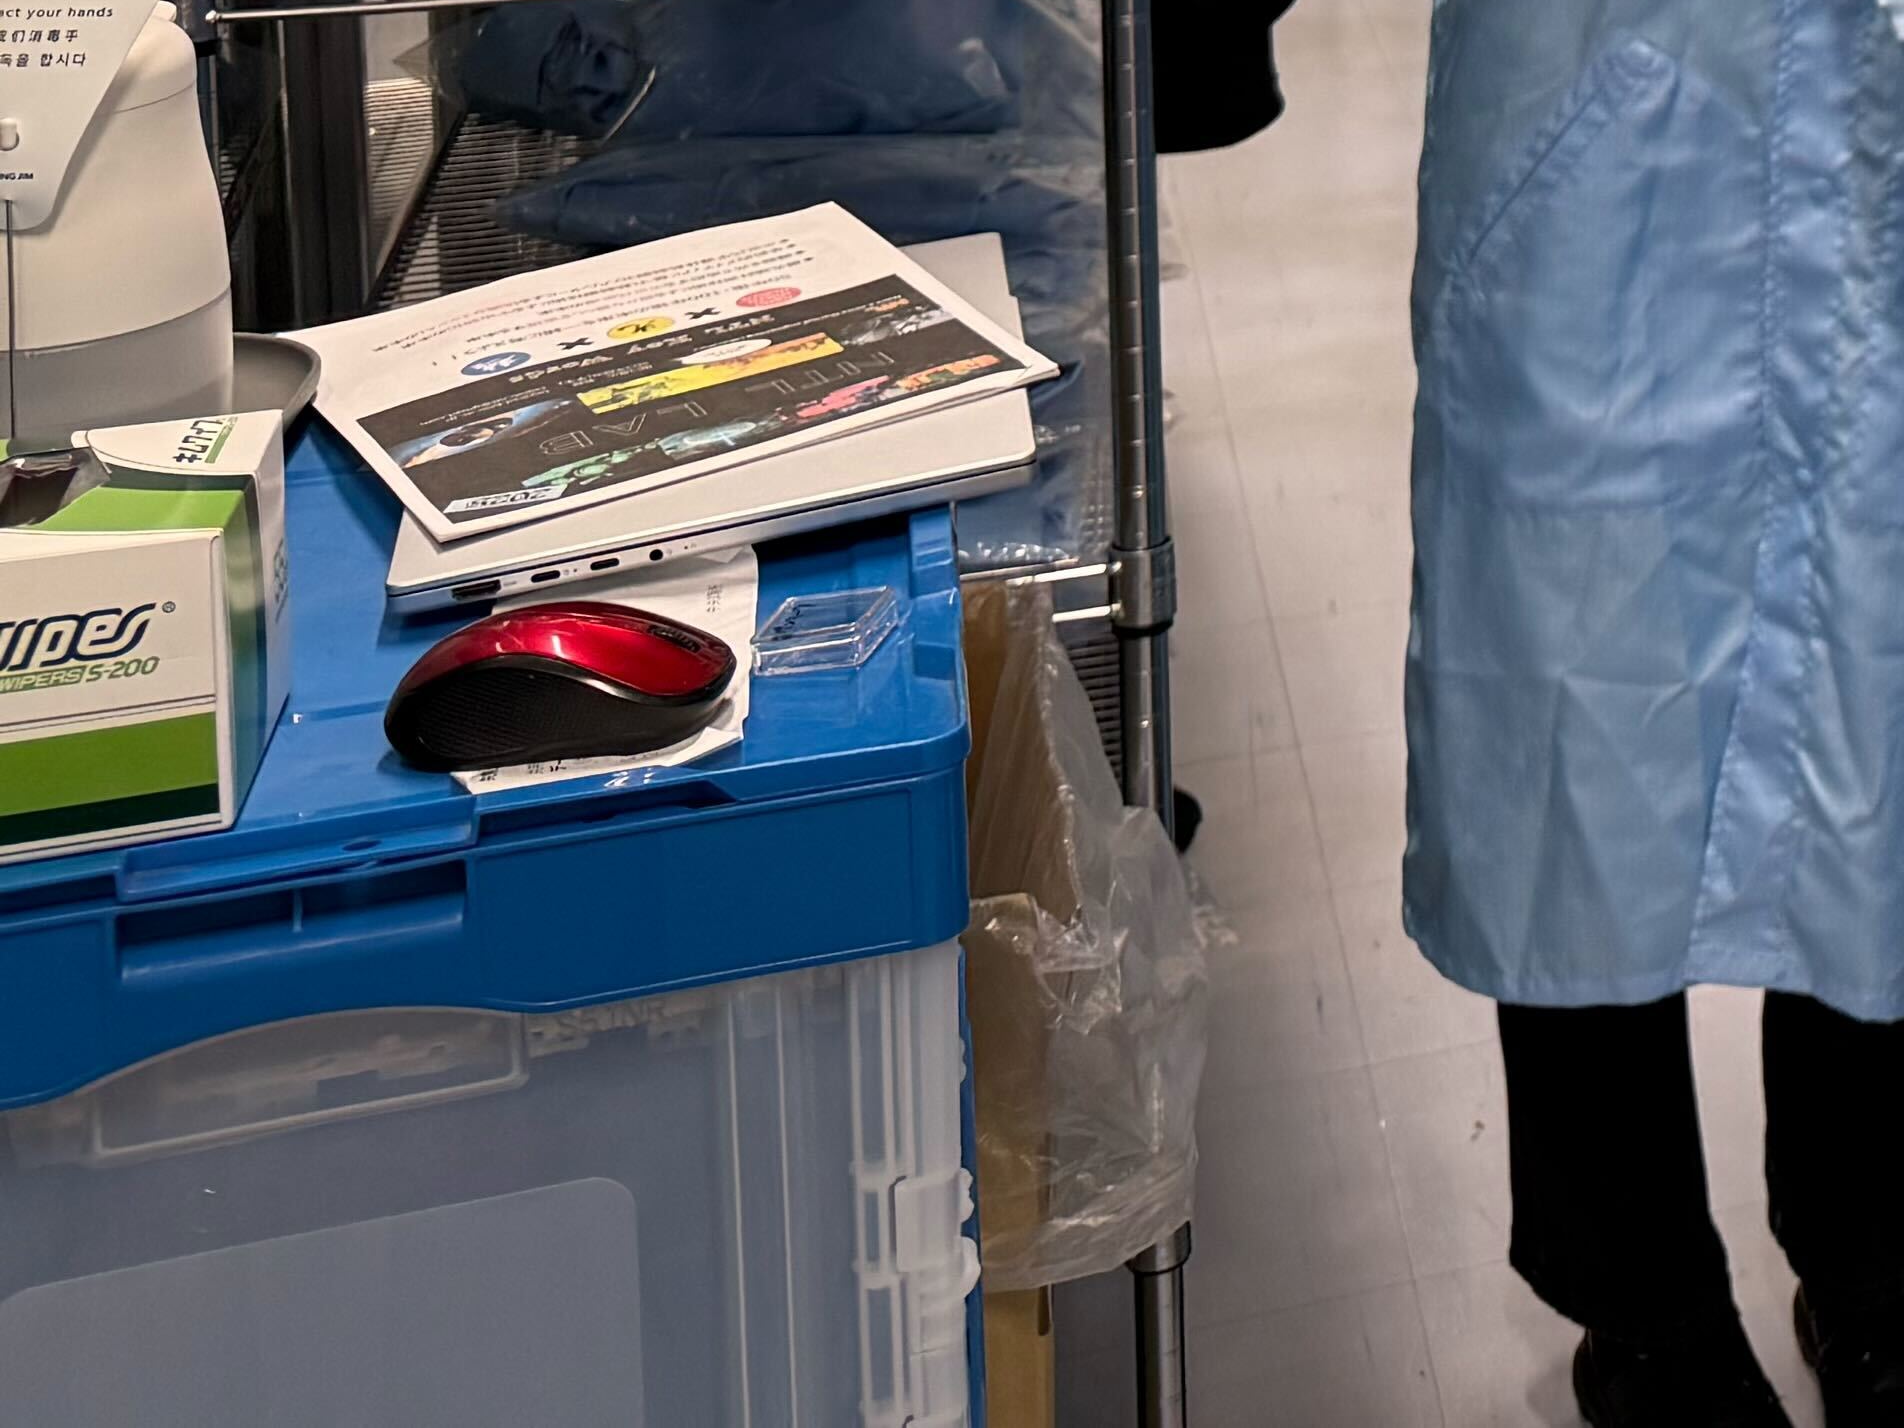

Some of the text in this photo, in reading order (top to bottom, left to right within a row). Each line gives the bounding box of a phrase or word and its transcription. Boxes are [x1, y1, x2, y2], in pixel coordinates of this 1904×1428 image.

[26, 9, 62, 20] your
[68, 7, 113, 18] hands
[40, 52, 86, 67] 합시다
[744, 351, 895, 394] NTL
[539, 401, 708, 455] LAB
[86, 656, 160, 683] S-200
